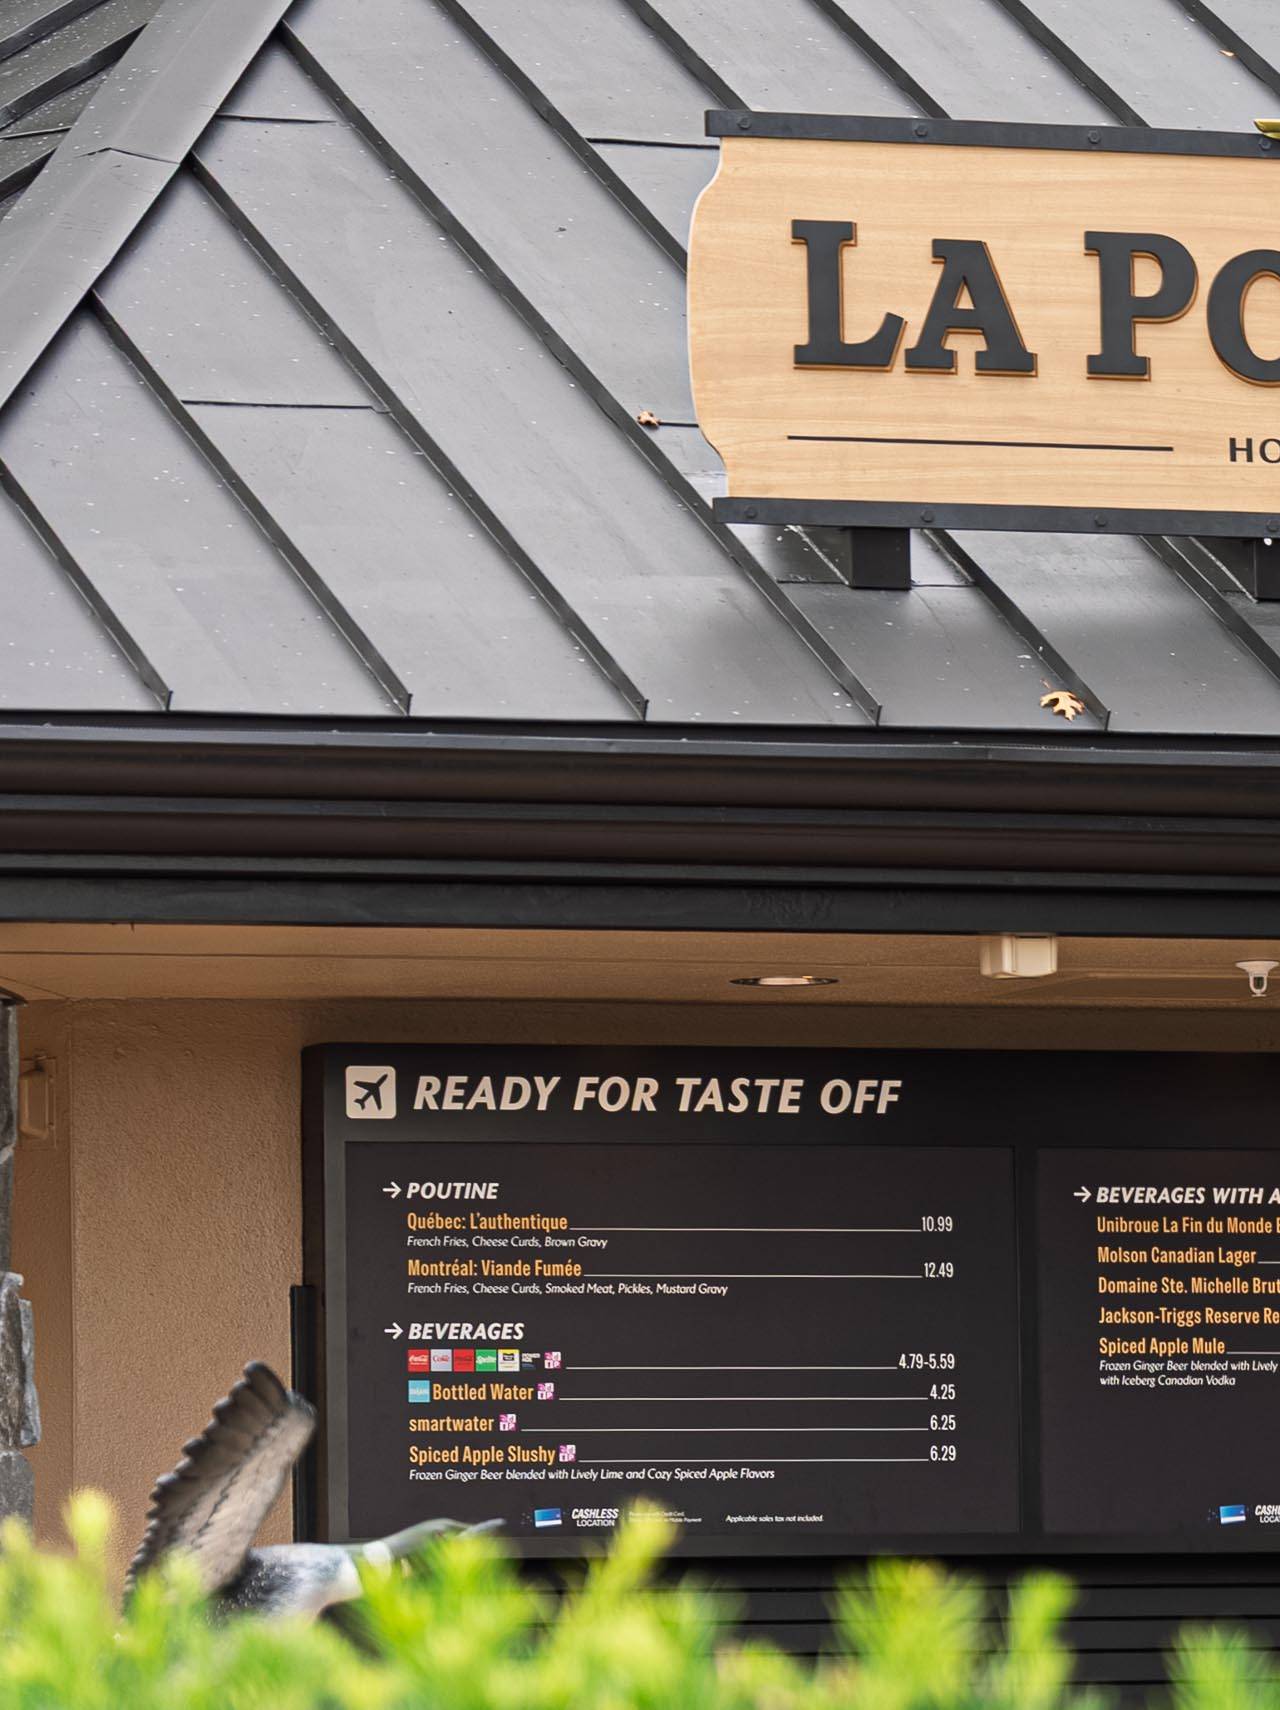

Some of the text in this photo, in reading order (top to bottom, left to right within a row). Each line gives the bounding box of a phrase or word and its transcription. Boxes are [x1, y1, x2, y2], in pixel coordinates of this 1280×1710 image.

[791, 219, 1037, 377] LA
[414, 1076, 902, 1114] READY FOR TASTE OFF
[407, 1182, 499, 1199] POUTINE
[1096, 1187, 1205, 1204] BEVERAGES
[1213, 1188, 1263, 1204] WITH
[408, 1212, 567, 1232] Québec: L'authentique
[920, 1216, 952, 1231] 10.99
[1097, 1216, 1159, 1233] Unibroue
[1163, 1217, 1178, 1232] La
[1183, 1217, 1202, 1232] Fin
[1207, 1217, 1223, 1233] du
[1227, 1217, 1272, 1233] Monde
[407, 1236, 608, 1248] French Fries, Cheese Curds, Brown Gravy
[1098, 1247, 1256, 1267] Molson Canadian Lager
[408, 1259, 581, 1276] Montréal: Viande Fumée
[924, 1262, 953, 1277] 12.49
[408, 1283, 728, 1296] French Fries, Cheese Curds, Smoked Meat, Pickles, Mustard Gravy
[1099, 1277, 1157, 1293] Domaine
[1162, 1277, 1187, 1293] Ste.
[1192, 1277, 1248, 1293] Michelle
[1099, 1307, 1201, 1327] Jackson-Triggs
[1206, 1308, 1260, 1324] Reserve
[408, 1323, 524, 1340] BEVERAGES
[1100, 1338, 1225, 1357] Spiced Apple Mule
[899, 1353, 955, 1369] 4.79-5.59
[1100, 1360, 1131, 1371] Frozen
[1133, 1360, 1163, 1373] Ginger
[1167, 1360, 1188, 1371] Beer
[1191, 1360, 1228, 1371] blended
[1231, 1361, 1250, 1370] with
[1252, 1361, 1278, 1372] Lively
[1100, 1375, 1235, 1388] with Iceberg Canadian Vodka
[433, 1384, 486, 1400] Bottled
[490, 1384, 534, 1400] Water
[930, 1384, 955, 1399] 4.25
[409, 1417, 494, 1431] smartwater
[930, 1415, 956, 1430] 6.25
[410, 1446, 555, 1466] Spiced Apple Slushy
[930, 1445, 956, 1461] 6.29
[409, 1468, 774, 1482] Frozen Ginger Beer blended with Lively Lime and Cozy Spiced Apple Flavors
[571, 1508, 619, 1520] CASHLESS
[576, 1519, 615, 1528] LOCATION
